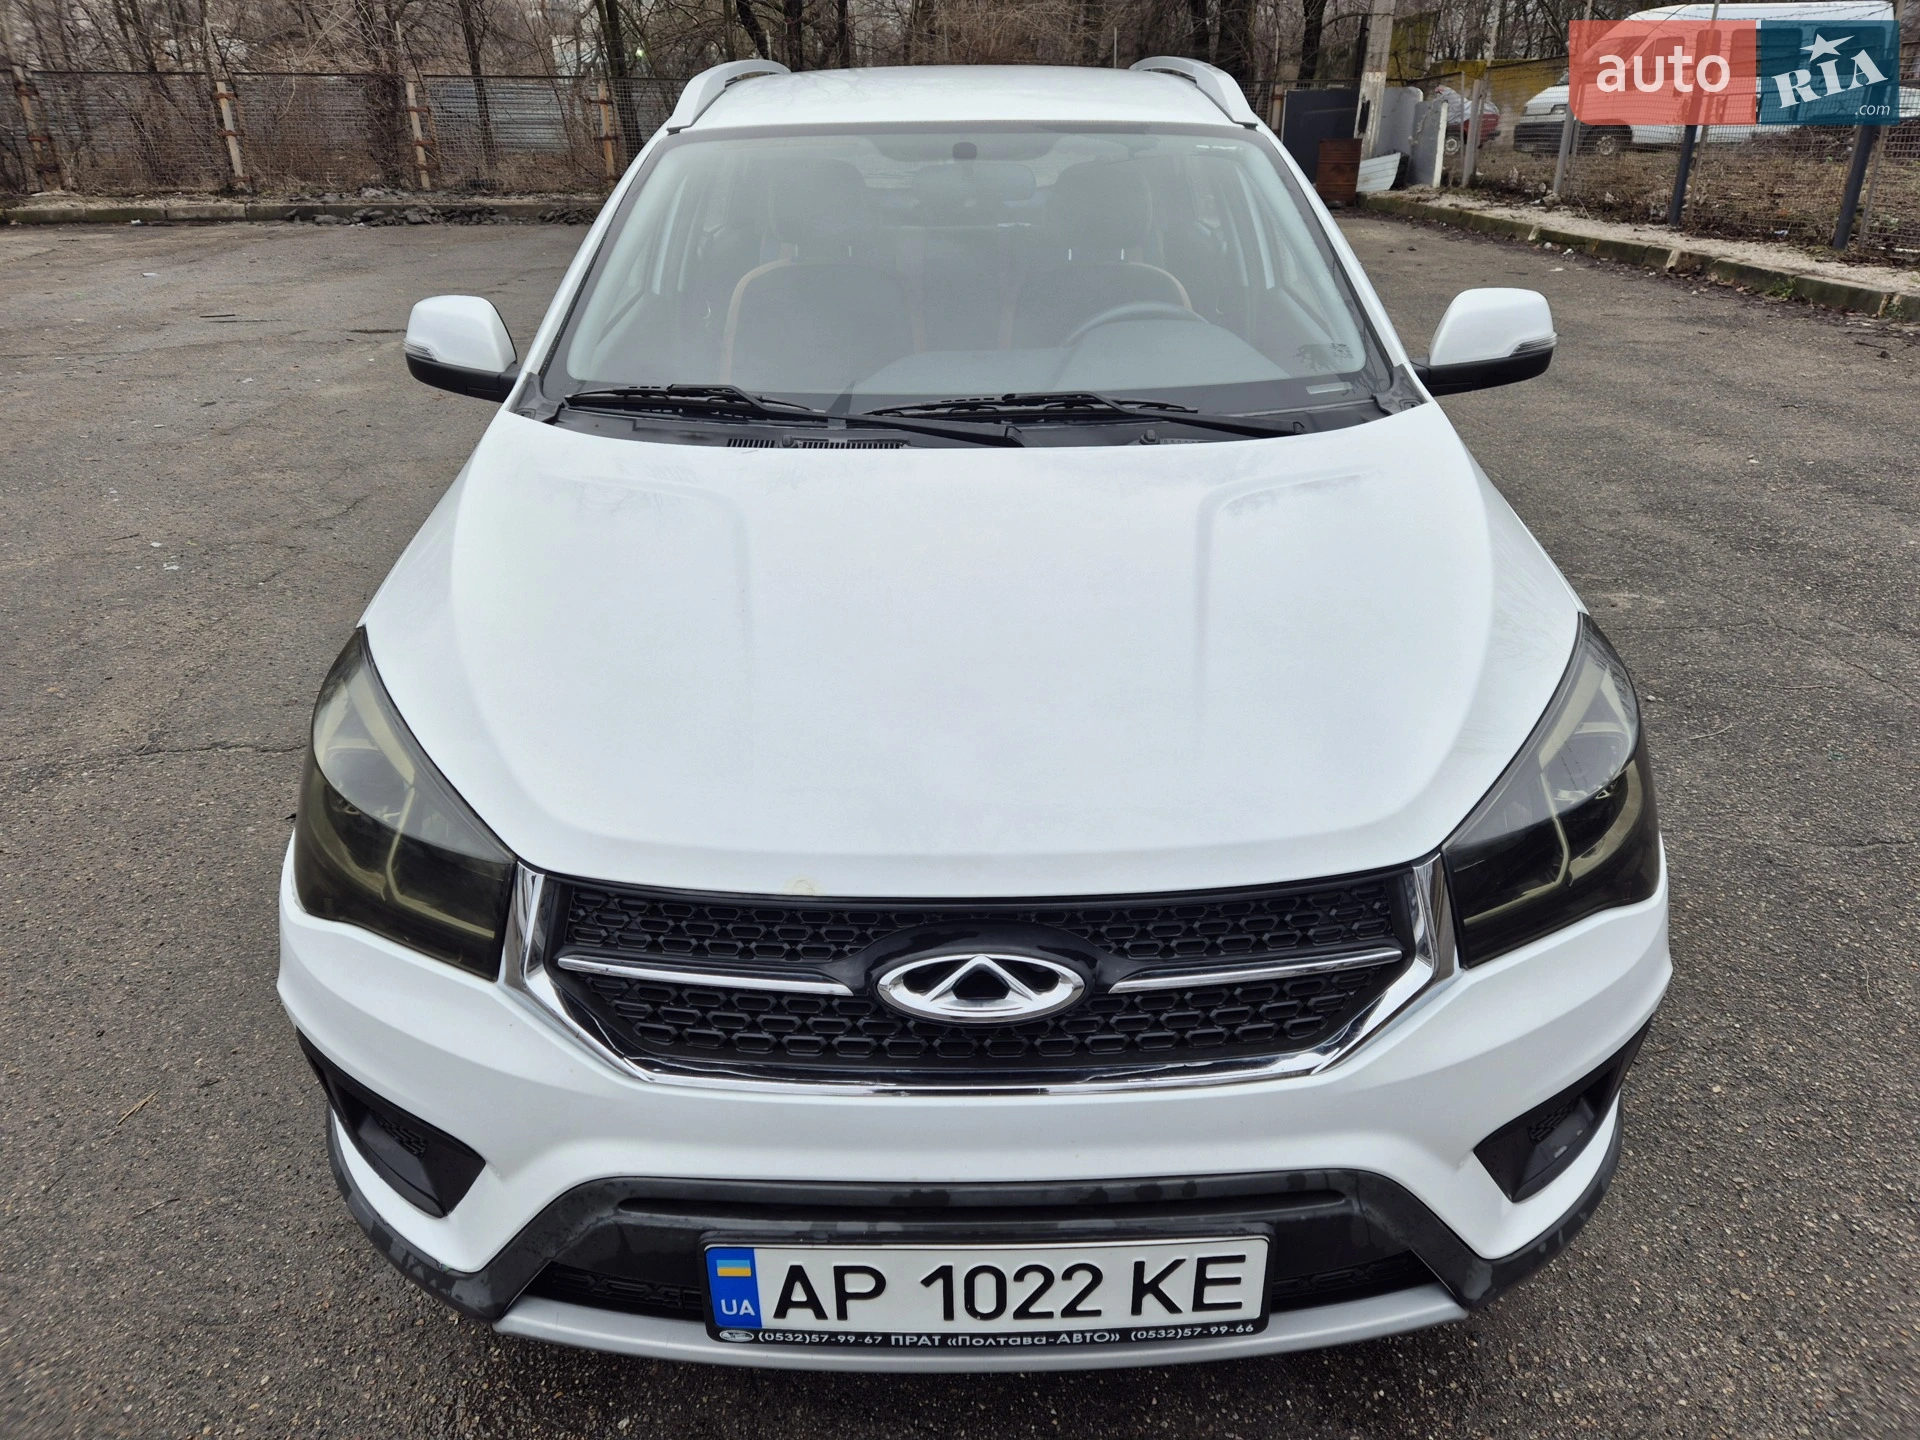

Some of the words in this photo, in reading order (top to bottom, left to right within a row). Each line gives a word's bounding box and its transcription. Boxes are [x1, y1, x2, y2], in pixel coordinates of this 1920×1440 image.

[772, 1264, 887, 1321] AP
[920, 1263, 1104, 1321] 1022
[1130, 1254, 1248, 1316] KE
[721, 1298, 756, 1317] UA
[758, 1331, 883, 1344] (0532)57-99-67
[890, 1335, 941, 1347] ПРАТ
[1130, 1324, 1254, 1342] (0532)57-99-66
